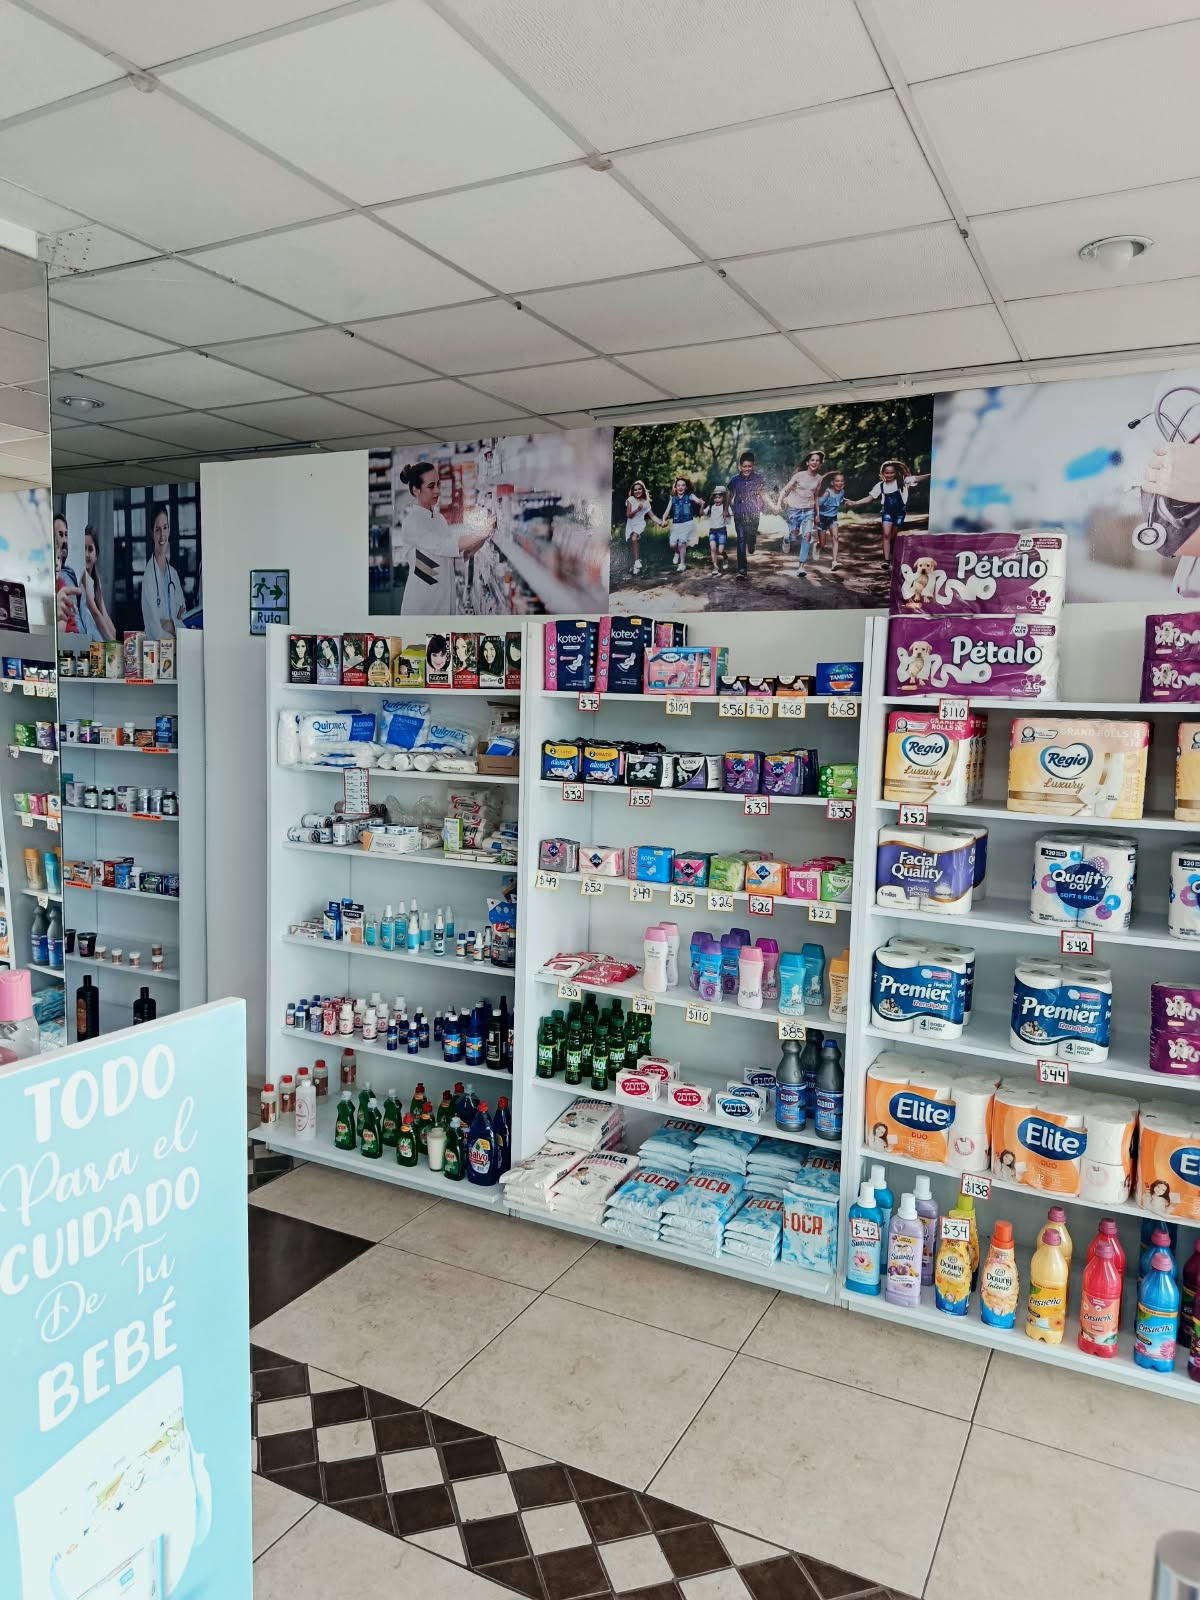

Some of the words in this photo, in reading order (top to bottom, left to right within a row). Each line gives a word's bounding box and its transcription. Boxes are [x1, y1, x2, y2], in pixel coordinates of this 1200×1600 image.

[954, 550, 1048, 580] Pétalo
[1031, 599, 1045, 608] 16
[258, 612, 281, 623] Ruta
[557, 633, 584, 644] kotex
[611, 628, 638, 639] kotex
[950, 635, 1043, 665] Pétalo
[581, 699, 598, 709] $75
[669, 702, 688, 713] $109
[722, 704, 744, 715] $56
[749, 704, 769, 715] $70
[782, 704, 802, 716] $68
[831, 702, 856, 715] $68
[942, 706, 966, 718] $110
[312, 721, 347, 733] Quirmex
[430, 725, 466, 744] Quirmex
[908, 741, 943, 756] Regio
[1048, 752, 1087, 768] Regio
[904, 765, 941, 780] Luxury
[1044, 778, 1086, 793] Luxury
[564, 790, 582, 800] $32
[632, 795, 650, 805] $55
[746, 802, 767, 814] $39
[831, 807, 852, 819] $35
[903, 812, 926, 824] $52
[900, 852, 938, 866] Facial
[891, 863, 943, 882] Quality
[540, 878, 557, 888] $49
[1052, 869, 1113, 889] Quality
[585, 883, 602, 893] $52
[633, 888, 650, 899] $49
[673, 894, 694, 904] $25
[711, 896, 732, 908] $26
[752, 904, 770, 913] $26
[811, 909, 832, 919] $22
[1066, 940, 1090, 951] $42
[560, 985, 577, 997] $30
[880, 974, 951, 1002] Premier
[913, 1000, 948, 1010] Rendiplus
[1022, 996, 1099, 1023] Premier
[688, 1011, 708, 1021] $110
[781, 1026, 804, 1039] $85
[1058, 1022, 1096, 1033] Rendiplus
[1042, 1069, 1065, 1082] $44
[624, 1082, 647, 1091] ZOTE
[24, 1044, 175, 1144] TODO
[677, 1093, 698, 1101] ZOTE
[781, 1093, 798, 1102] CLOROX
[725, 1104, 748, 1112] ZOTE
[817, 1099, 834, 1108] CLOROX
[896, 1098, 948, 1126] Elite
[664, 1120, 706, 1133] FOCA
[1026, 1122, 1079, 1154] Elite
[0, 1147, 138, 1226] Para
[154, 1096, 198, 1160] el
[634, 1171, 680, 1192] FOCA
[684, 1176, 731, 1195] FOCA
[964, 1184, 989, 1198] $138
[0, 1166, 200, 1295] CUIDADO
[854, 1224, 876, 1237] $42
[944, 1224, 967, 1238] $34
[940, 1259, 965, 1274] Downy
[986, 1273, 1012, 1286] Downy
[35, 1281, 107, 1343] De
[121, 1232, 176, 1295] Tu
[38, 1286, 176, 1432] BEBÉ
